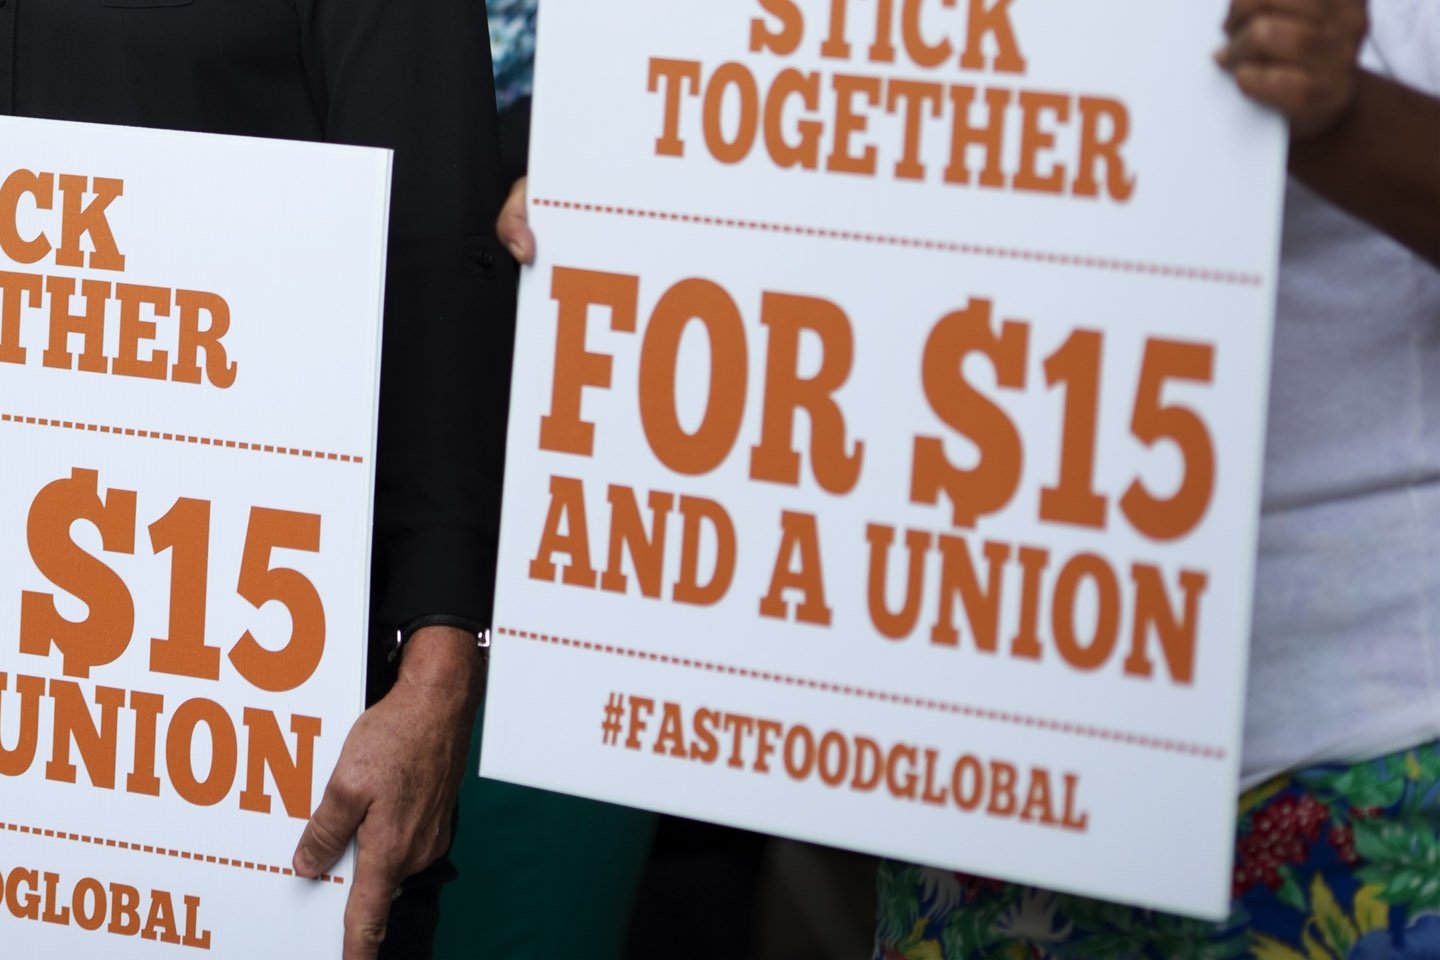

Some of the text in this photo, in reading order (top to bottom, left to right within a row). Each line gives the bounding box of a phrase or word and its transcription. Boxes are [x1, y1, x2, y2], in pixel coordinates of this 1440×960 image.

[648, 58, 1136, 201] TOGETHER
[539, 266, 1217, 543] FOR $15
[19, 468, 326, 693] $15
[528, 474, 1208, 686] AND A UNION
[601, 691, 1089, 834] #FASTFOODGLOBAL
